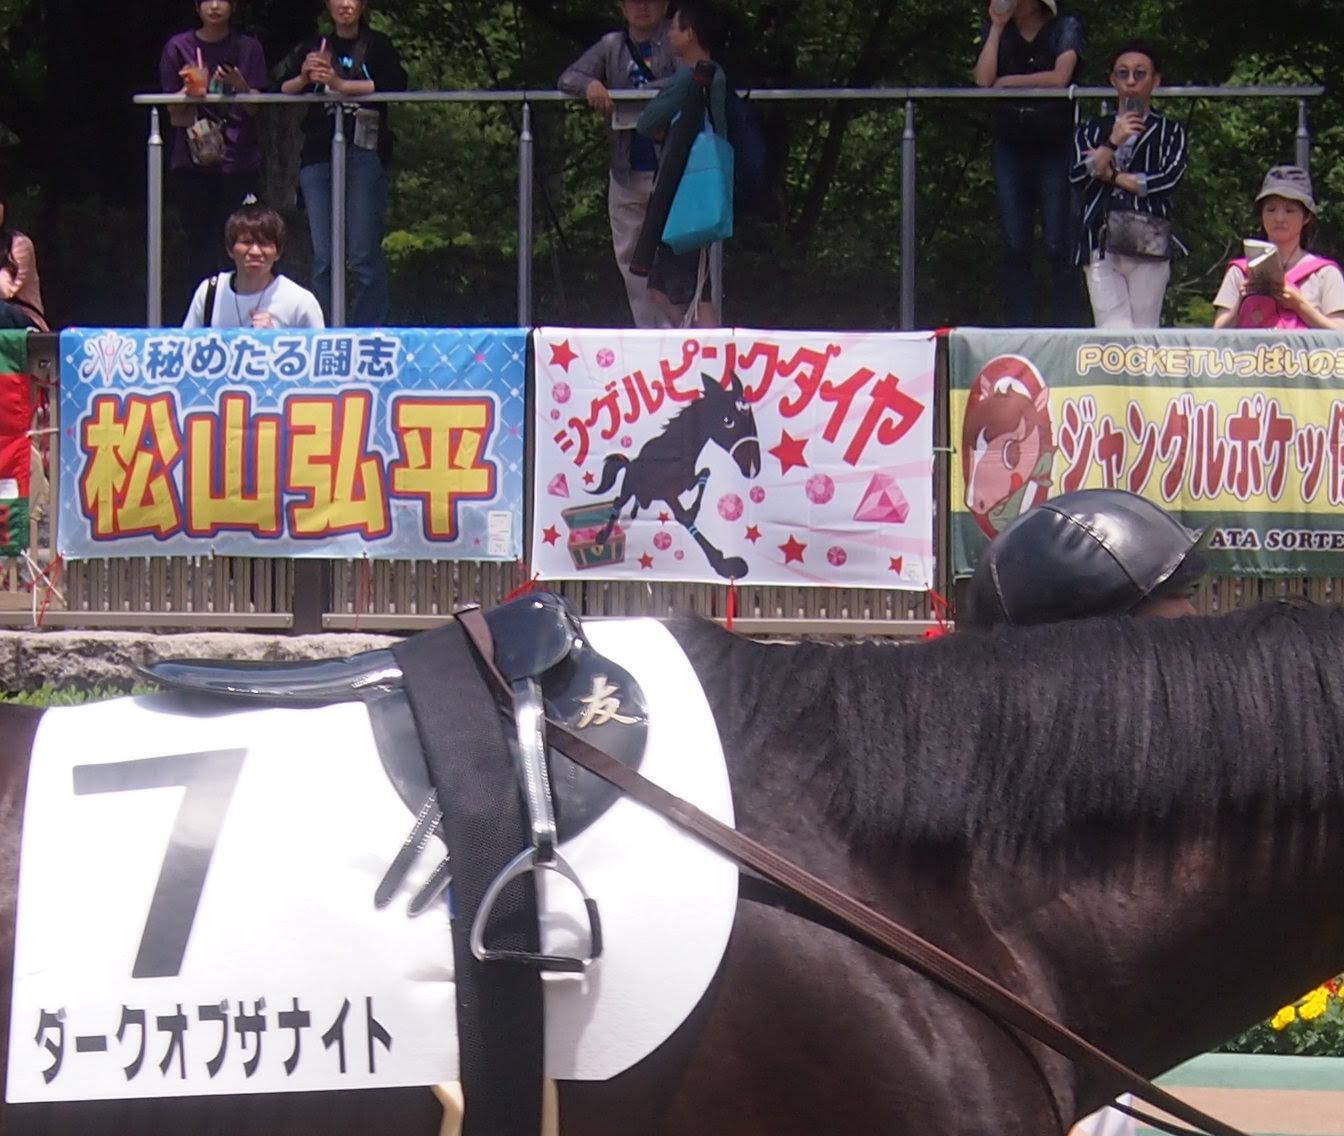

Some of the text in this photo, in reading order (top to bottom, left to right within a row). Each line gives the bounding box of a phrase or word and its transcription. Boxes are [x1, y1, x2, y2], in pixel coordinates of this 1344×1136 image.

[145, 336, 399, 380] 秘めたる闘志
[553, 338, 925, 467] シゲルピンクダイヤ
[81, 394, 497, 541] 松山弘平
[72, 748, 248, 980] 7
[34, 996, 393, 1085] ダークオブザナイト
